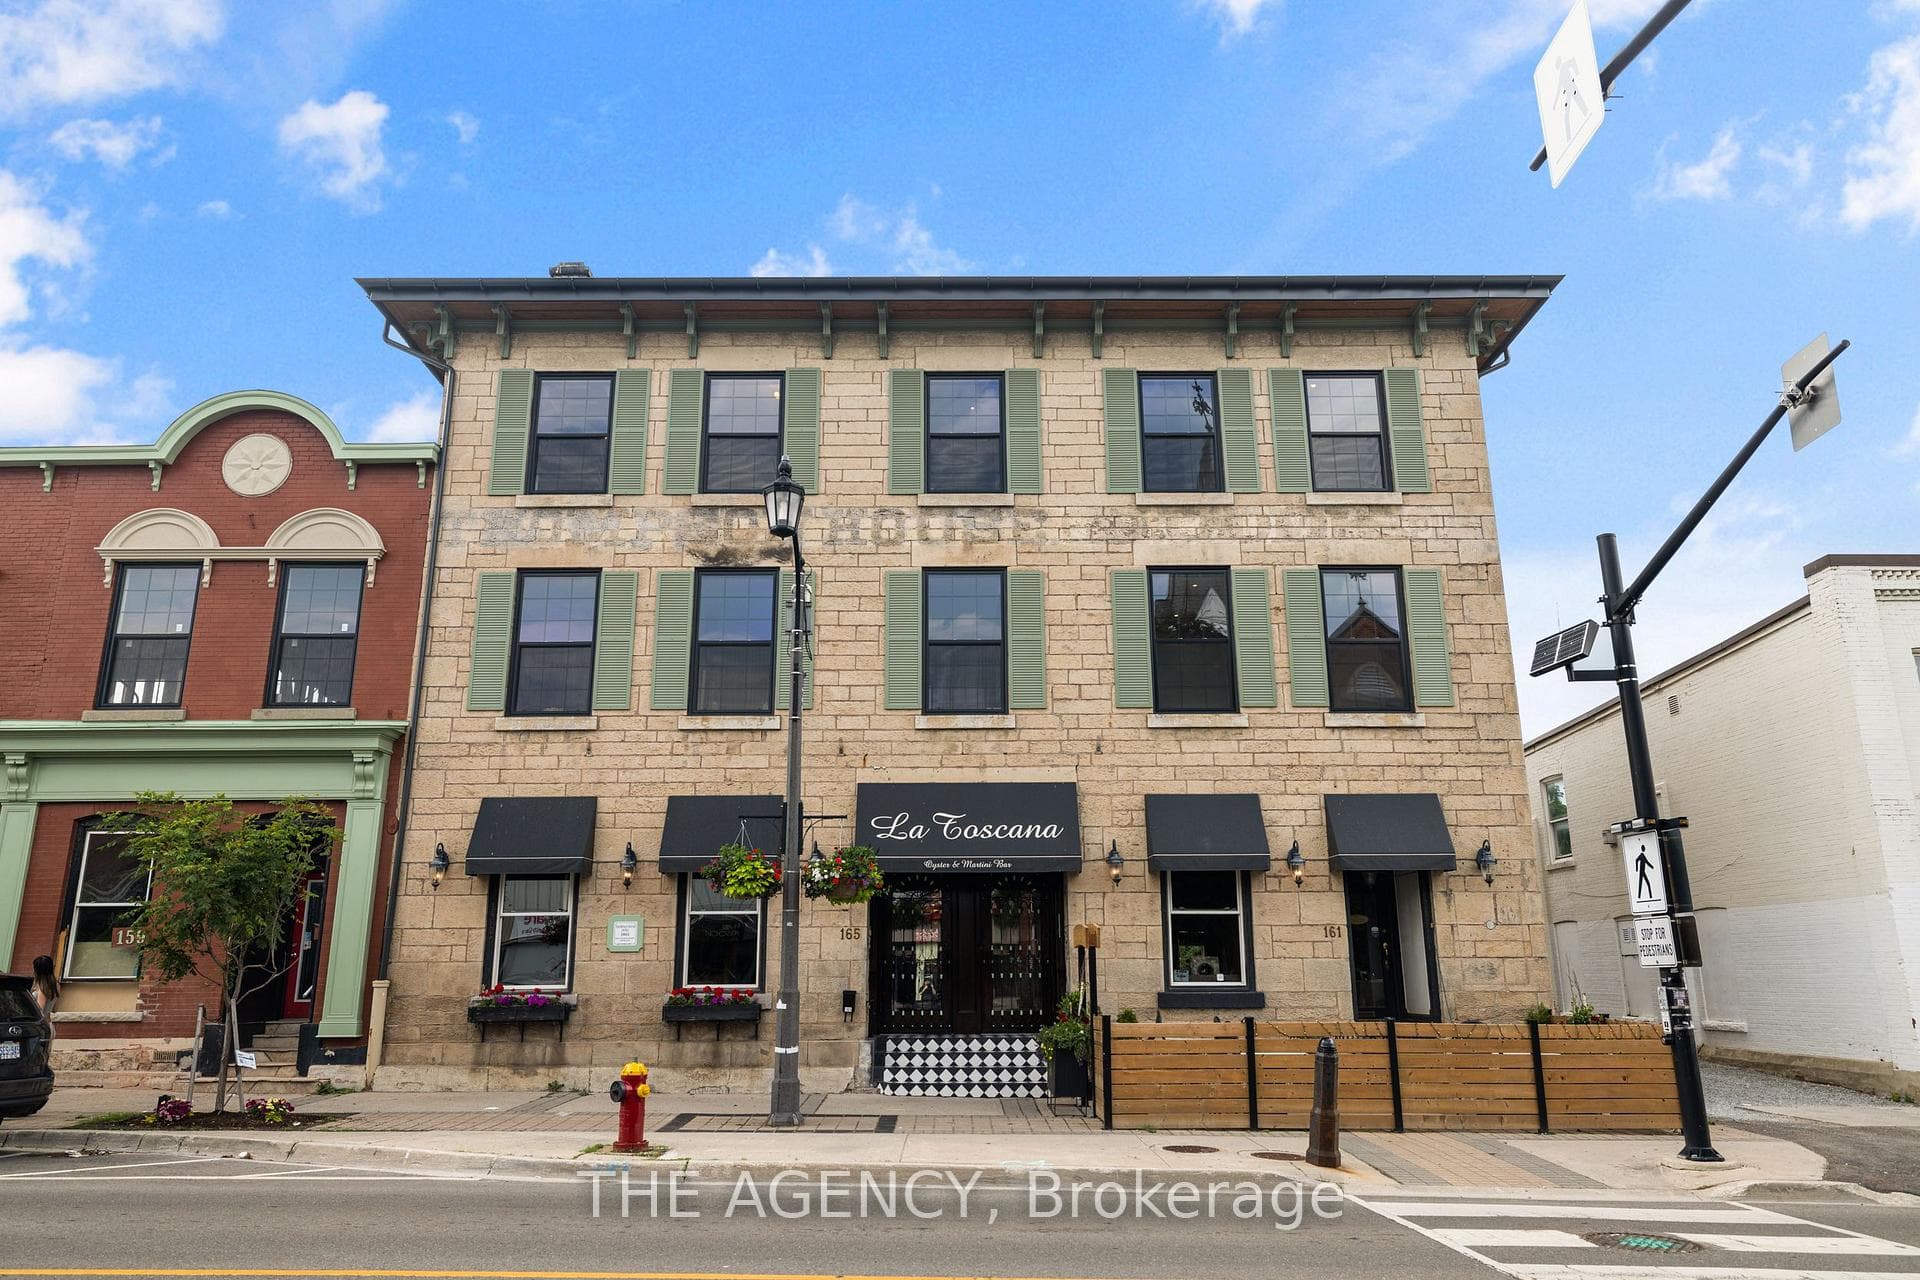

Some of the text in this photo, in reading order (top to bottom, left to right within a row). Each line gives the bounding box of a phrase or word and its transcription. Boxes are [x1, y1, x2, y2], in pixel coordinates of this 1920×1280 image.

[871, 812, 1064, 840] La Toscana
[924, 860, 1012, 871] Oyster & Martini Bar
[840, 927, 861, 940] 165
[1323, 925, 1342, 938] 161
[1640, 927, 1667, 941] STOP FOR
[1639, 943, 1674, 958] PEDESTRIANS
